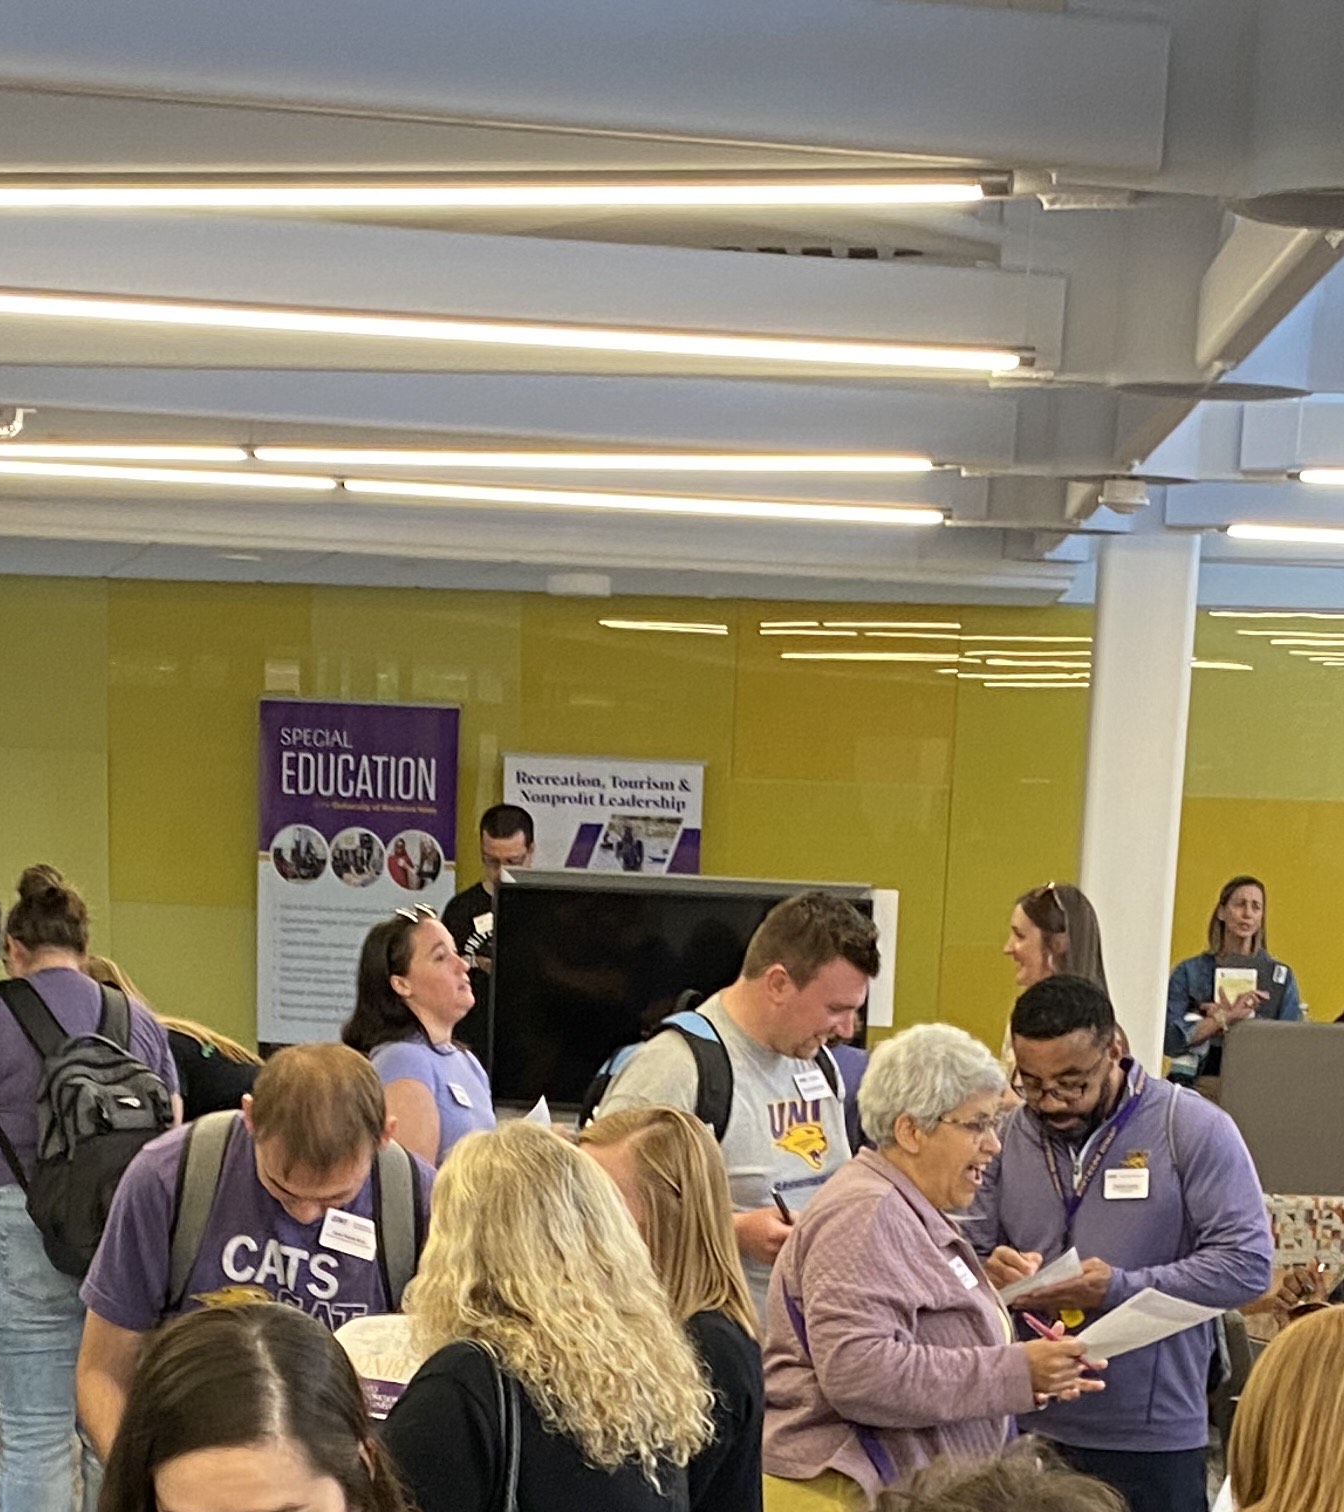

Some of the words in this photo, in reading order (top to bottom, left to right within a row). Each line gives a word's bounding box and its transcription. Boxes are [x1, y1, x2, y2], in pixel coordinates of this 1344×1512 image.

[280, 727, 353, 748] SPECIAL
[281, 751, 436, 801] EDUCATION
[515, 770, 605, 789] Recreation,
[611, 775, 675, 791] Tourism
[679, 779, 691, 792] &
[520, 790, 595, 807] Nonprofit
[599, 793, 686, 812] Leadership
[768, 1099, 820, 1139] UNI
[222, 1234, 339, 1300] CATS
